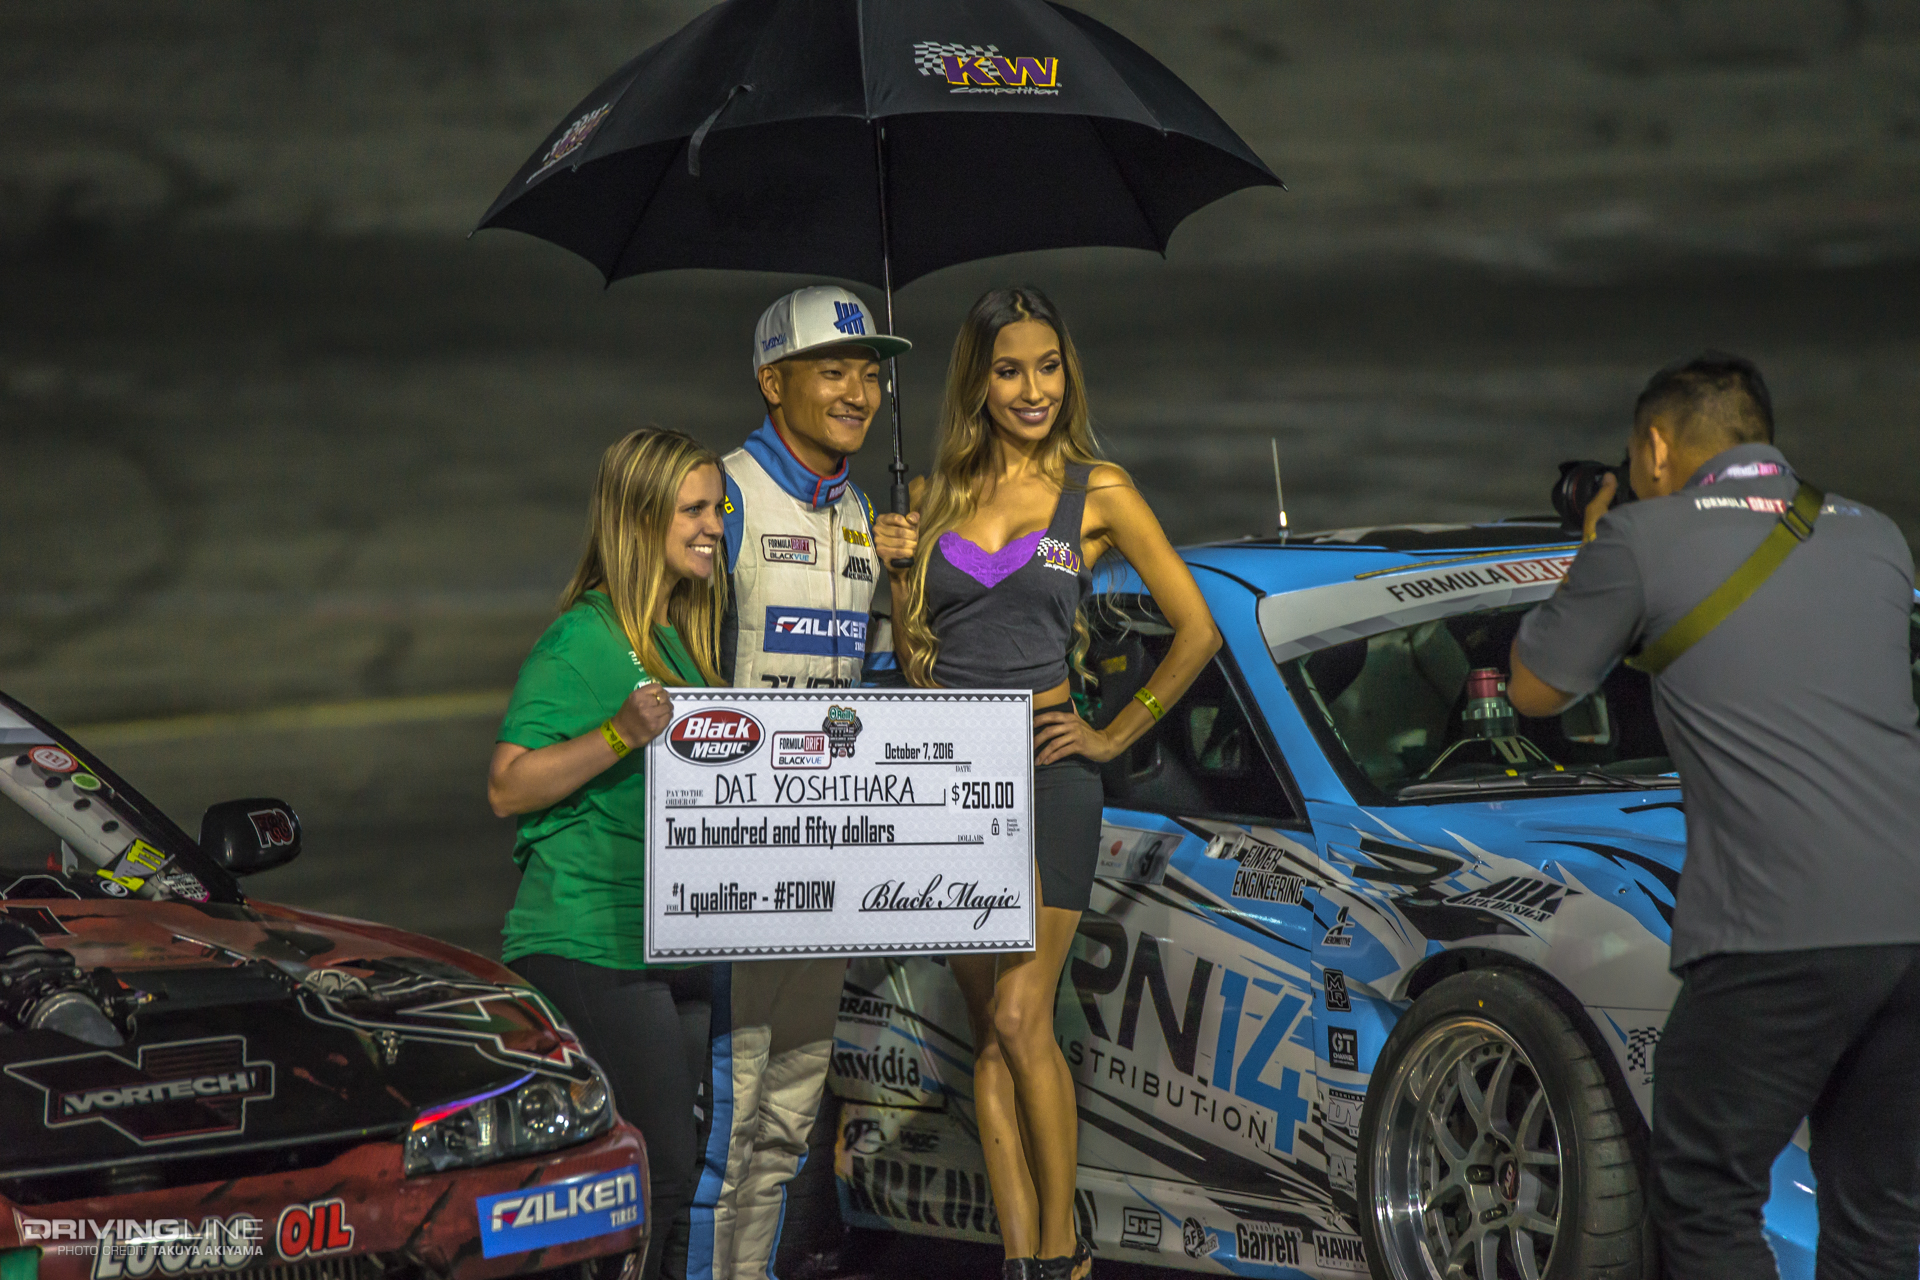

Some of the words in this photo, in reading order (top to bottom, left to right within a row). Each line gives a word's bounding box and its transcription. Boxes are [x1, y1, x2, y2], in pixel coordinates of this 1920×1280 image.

[940, 55, 1059, 87] KW
[950, 87, 1059, 96] Competition
[768, 538, 791, 549] FORMULA
[769, 552, 810, 562] BLACKVUE
[1046, 546, 1080, 572] KW
[1386, 568, 1510, 602] FORMULA
[1507, 555, 1576, 582] DRIF
[775, 616, 867, 640] FALKEN
[683, 717, 752, 739] Black
[690, 741, 746, 759] Magic
[780, 737, 804, 751] FORMULA
[805, 736, 825, 751] DRIFT
[885, 743, 920, 760] October
[923, 743, 931, 761] 7,
[934, 743, 954, 760] 2016
[779, 756, 822, 765] BLACKVUE
[715, 773, 757, 805] DAI
[774, 773, 915, 806] YOSHIHARA
[952, 782, 1015, 810] $250.00
[666, 817, 696, 846] Two
[702, 816, 768, 845] hundred
[773, 816, 801, 844] and
[806, 816, 838, 850] fifty
[842, 815, 895, 842] dollars
[957, 834, 984, 842] DOLLARS
[1241, 844, 1284, 872] EIMER
[672, 883, 685, 912] #1
[690, 883, 757, 918] qualifier
[774, 881, 837, 910] #FDIRW
[862, 873, 943, 910] Black
[938, 880, 1020, 930] Magic
[1231, 869, 1306, 906] ENGINEERING
[666, 904, 679, 912] FOR
[1489, 899, 1552, 922] DESIGN
[64, 1072, 250, 1116] VORTECH
[1060, 1034, 1267, 1144] ISTRIBUTION
[491, 1173, 637, 1233] FALKEN
[610, 1204, 638, 1228] TIRES
[279, 1200, 353, 1258] OIL
[95, 1213, 258, 1279] LUCAS
[1236, 1222, 1300, 1265] Garrett
[1315, 1235, 1367, 1263] HAWK
